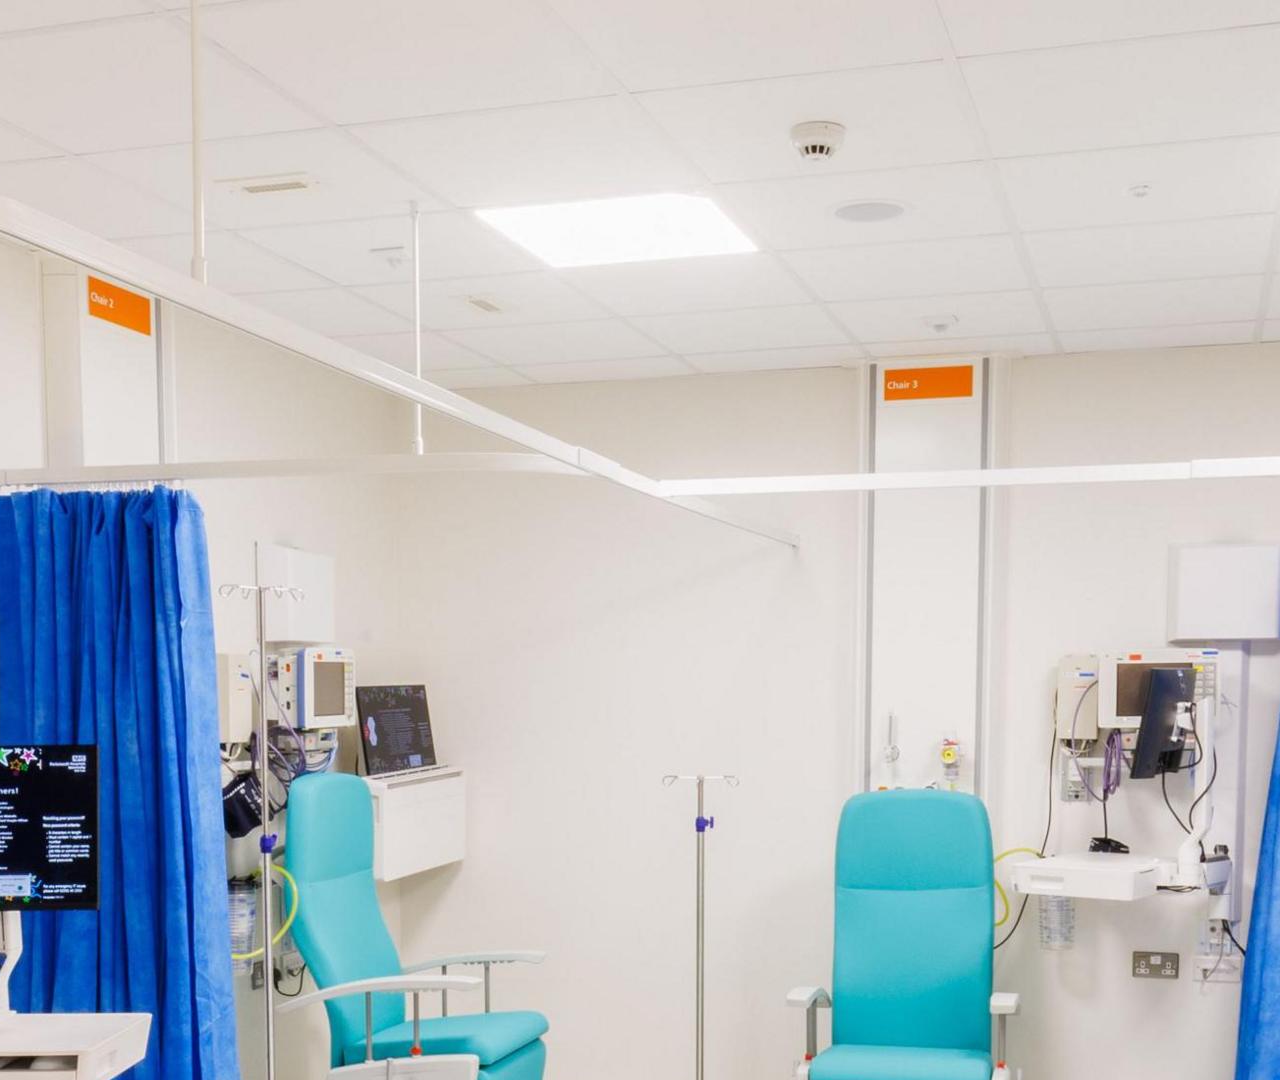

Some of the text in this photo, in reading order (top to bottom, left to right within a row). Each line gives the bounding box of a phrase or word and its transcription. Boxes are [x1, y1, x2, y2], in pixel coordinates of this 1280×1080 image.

[90, 291, 115, 309] Chair 2
[887, 379, 919, 390] Chair 3
